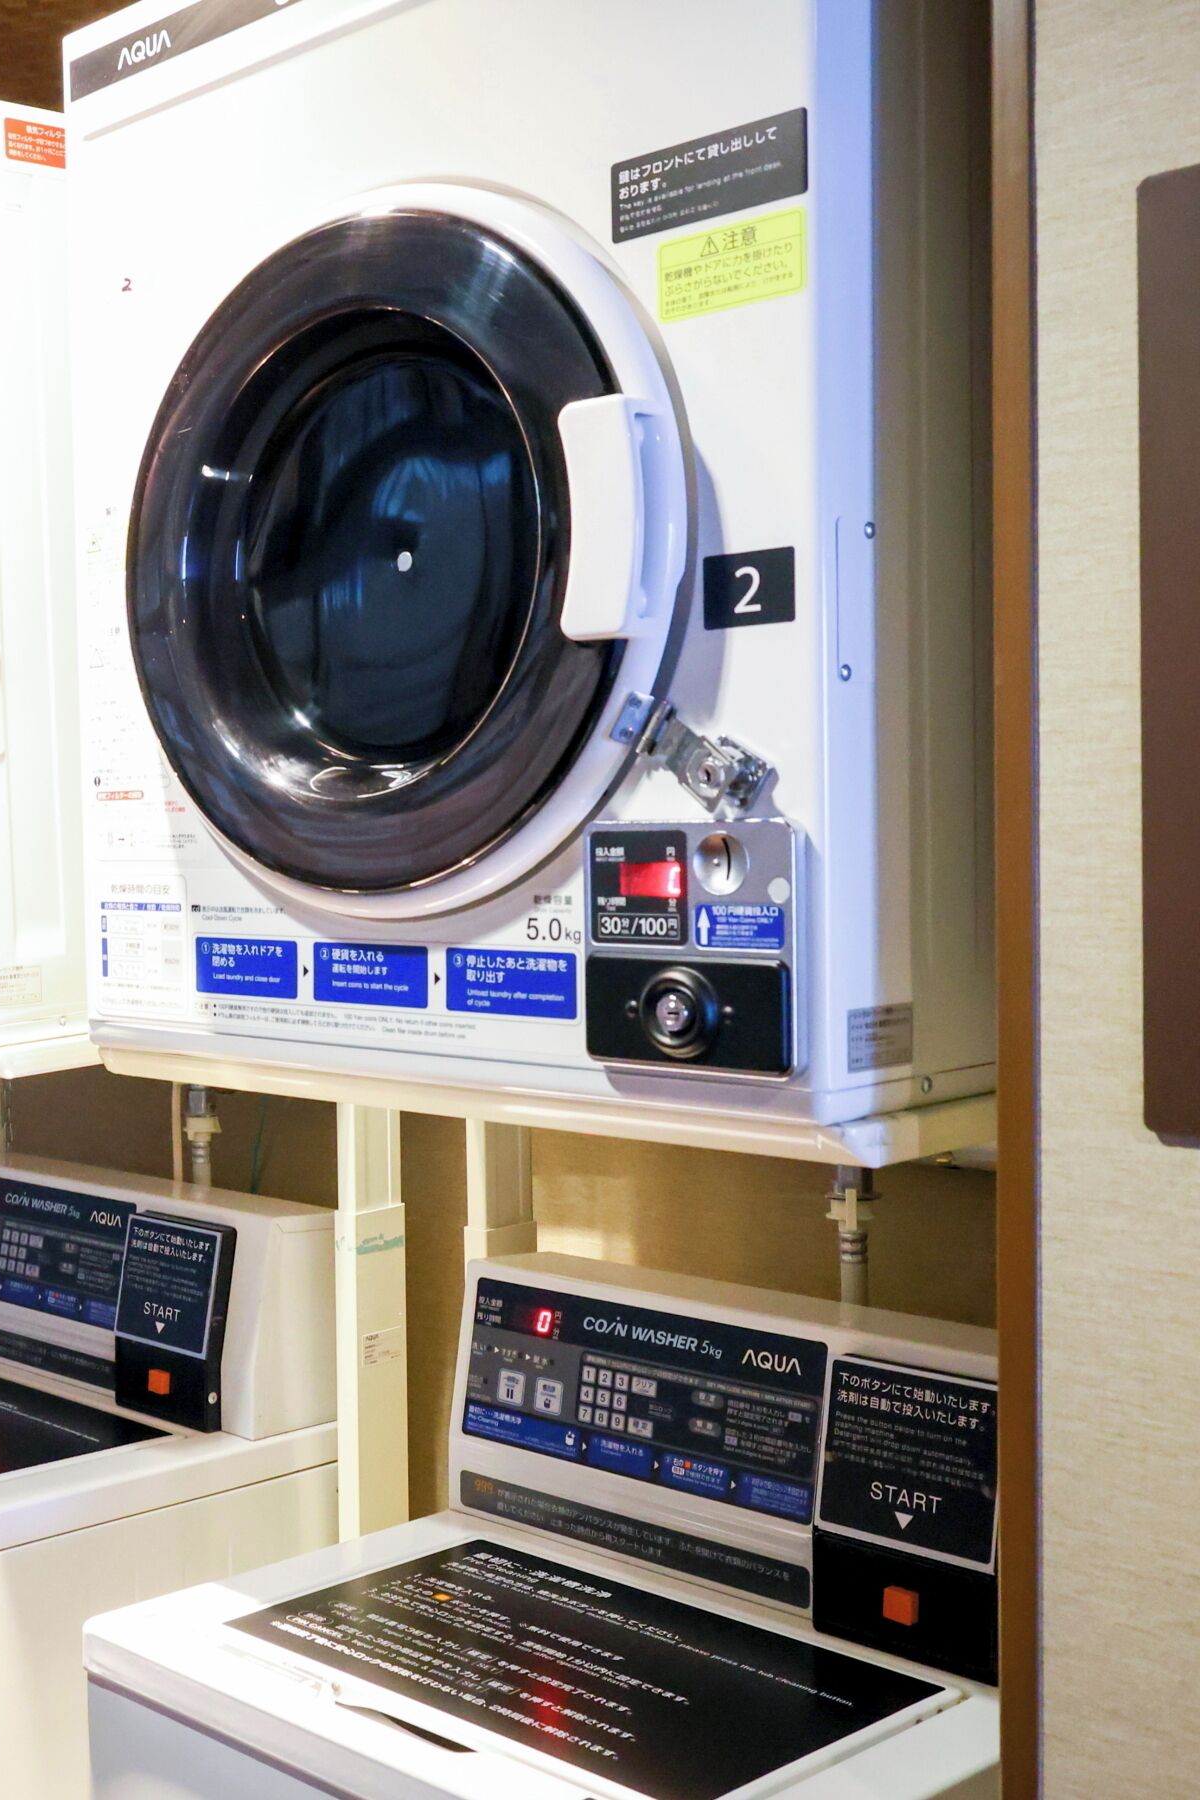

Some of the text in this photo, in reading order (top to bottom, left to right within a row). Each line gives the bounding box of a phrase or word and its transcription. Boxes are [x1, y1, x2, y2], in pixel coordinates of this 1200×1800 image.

[118, 29, 171, 70] AQUA
[618, 127, 778, 184] 鍵はフロントにて貸し出しして
[618, 178, 667, 200] おります。
[723, 226, 757, 251] 注意
[734, 566, 761, 613] 2
[526, 918, 582, 943] 5.0 kg
[332, 949, 384, 962] 硬貨を入れる
[466, 955, 567, 972] 停止したあと洗濯物を
[332, 964, 387, 975] 運転を開始します
[466, 969, 505, 983] 取り出す
[31, 1198, 68, 1214] WASHER
[89, 1210, 122, 1228] AQUA
[144, 1301, 181, 1322] START
[536, 1310, 552, 1333] 0
[554, 1311, 562, 1320] 円
[632, 1325, 699, 1352] WASHER
[699, 1340, 723, 1359] 5kg
[741, 1349, 802, 1377] AQUA
[839, 1372, 996, 1416] 下のボタンにて始動いたします。
[836, 1411, 855, 1422] Press
[857, 1415, 868, 1424] the
[870, 1418, 892, 1430] button
[837, 1389, 985, 1432] 洗剤は自動で投入いたします。
[870, 1481, 942, 1514] START
[708, 1654, 741, 1665] press
